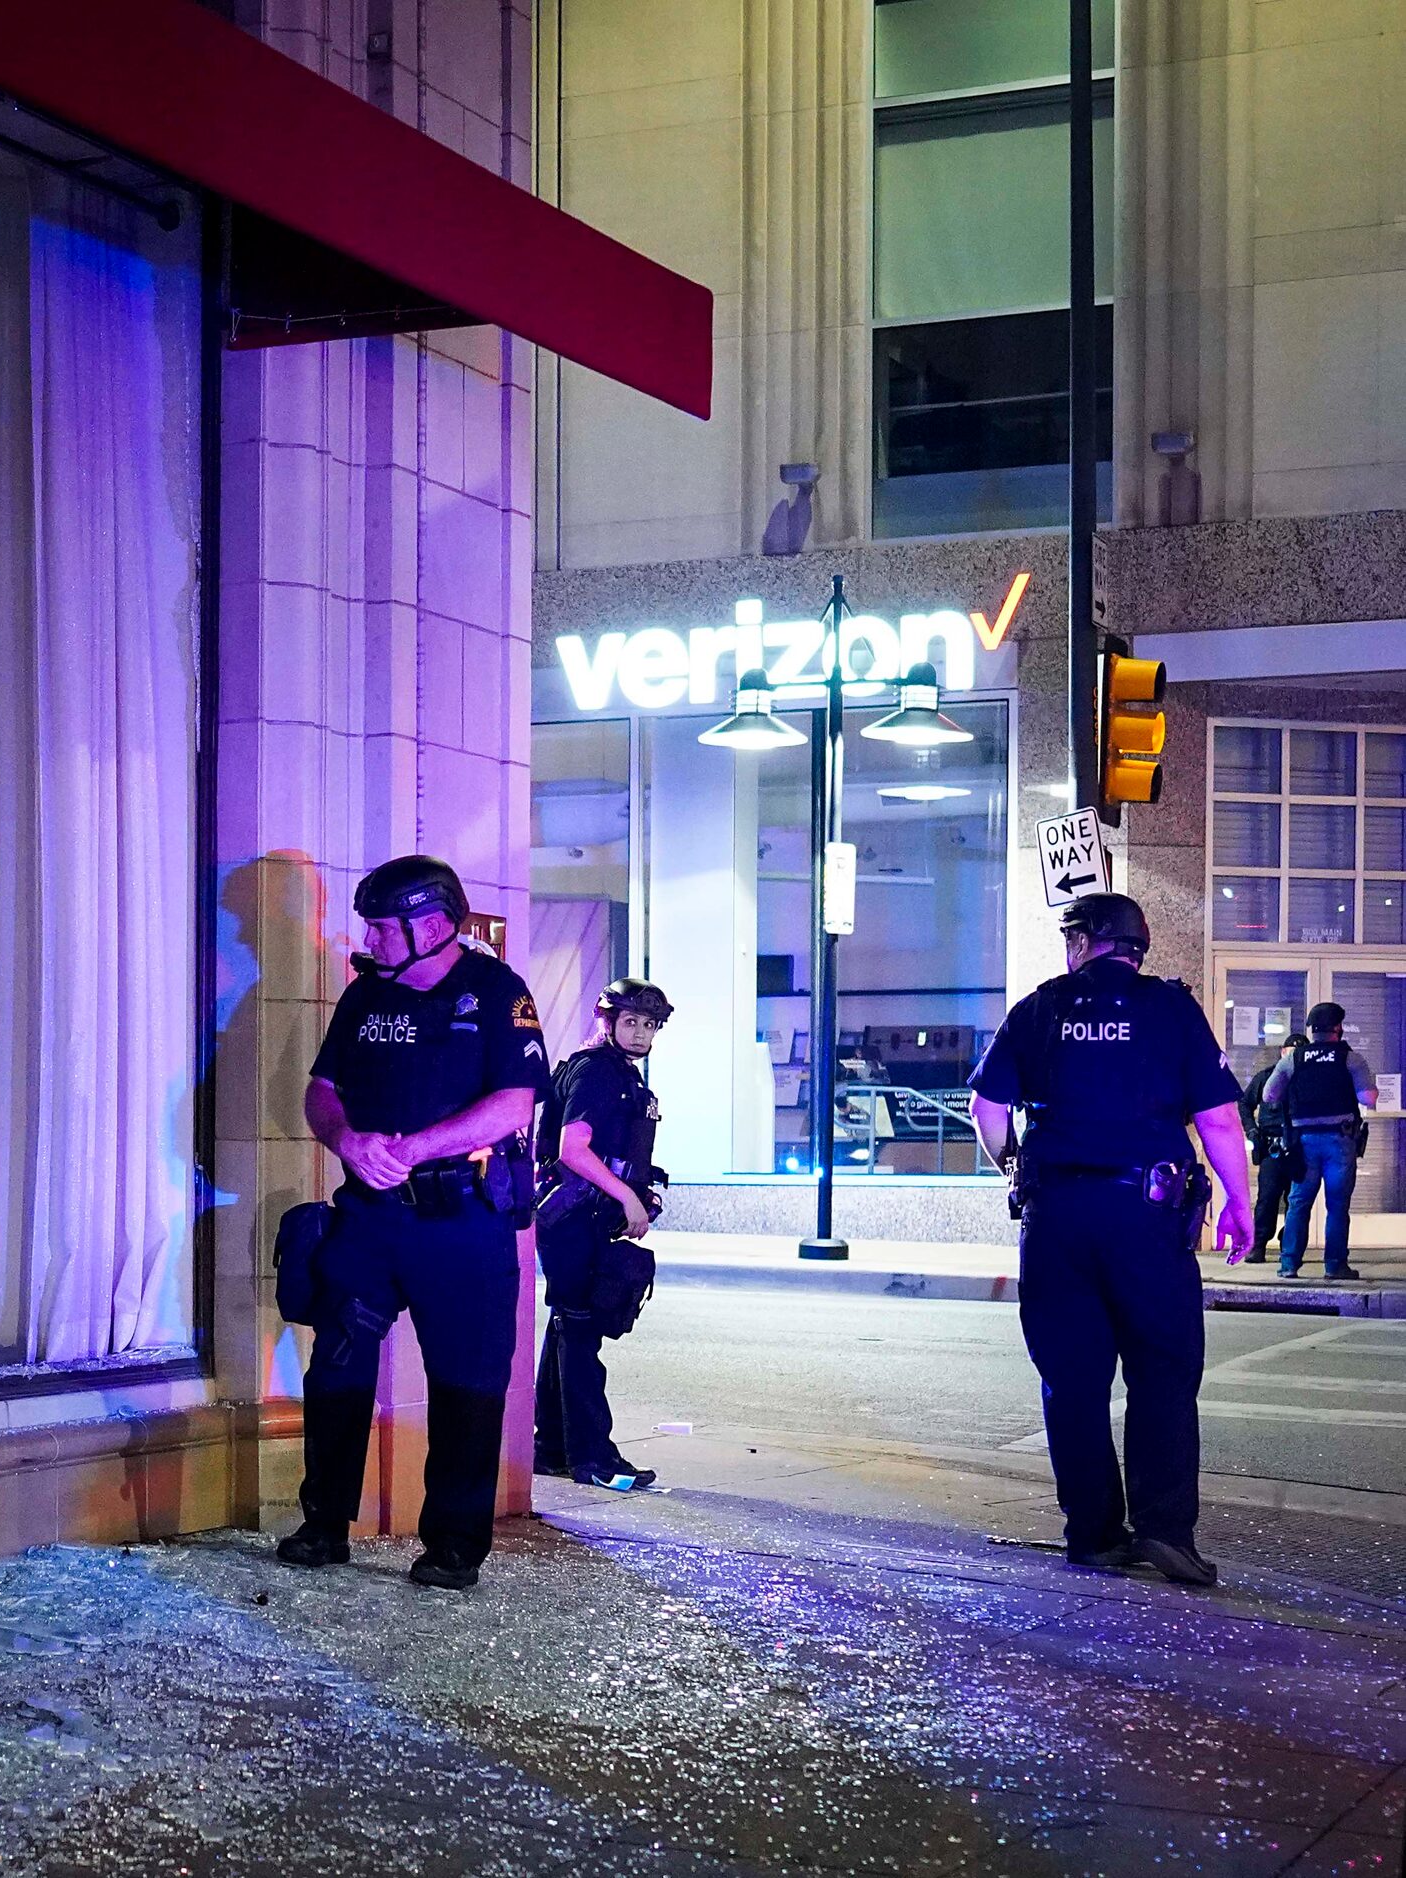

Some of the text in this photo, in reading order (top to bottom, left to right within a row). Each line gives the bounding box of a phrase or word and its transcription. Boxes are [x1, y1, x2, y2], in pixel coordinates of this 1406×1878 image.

[555, 599, 975, 710] verizon
[1046, 818, 1092, 845] ONE
[1048, 841, 1094, 870] WAY
[367, 1014, 410, 1026] DALLAS
[1061, 1022, 1131, 1041] POLICE
[358, 1025, 417, 1043] POLICE
